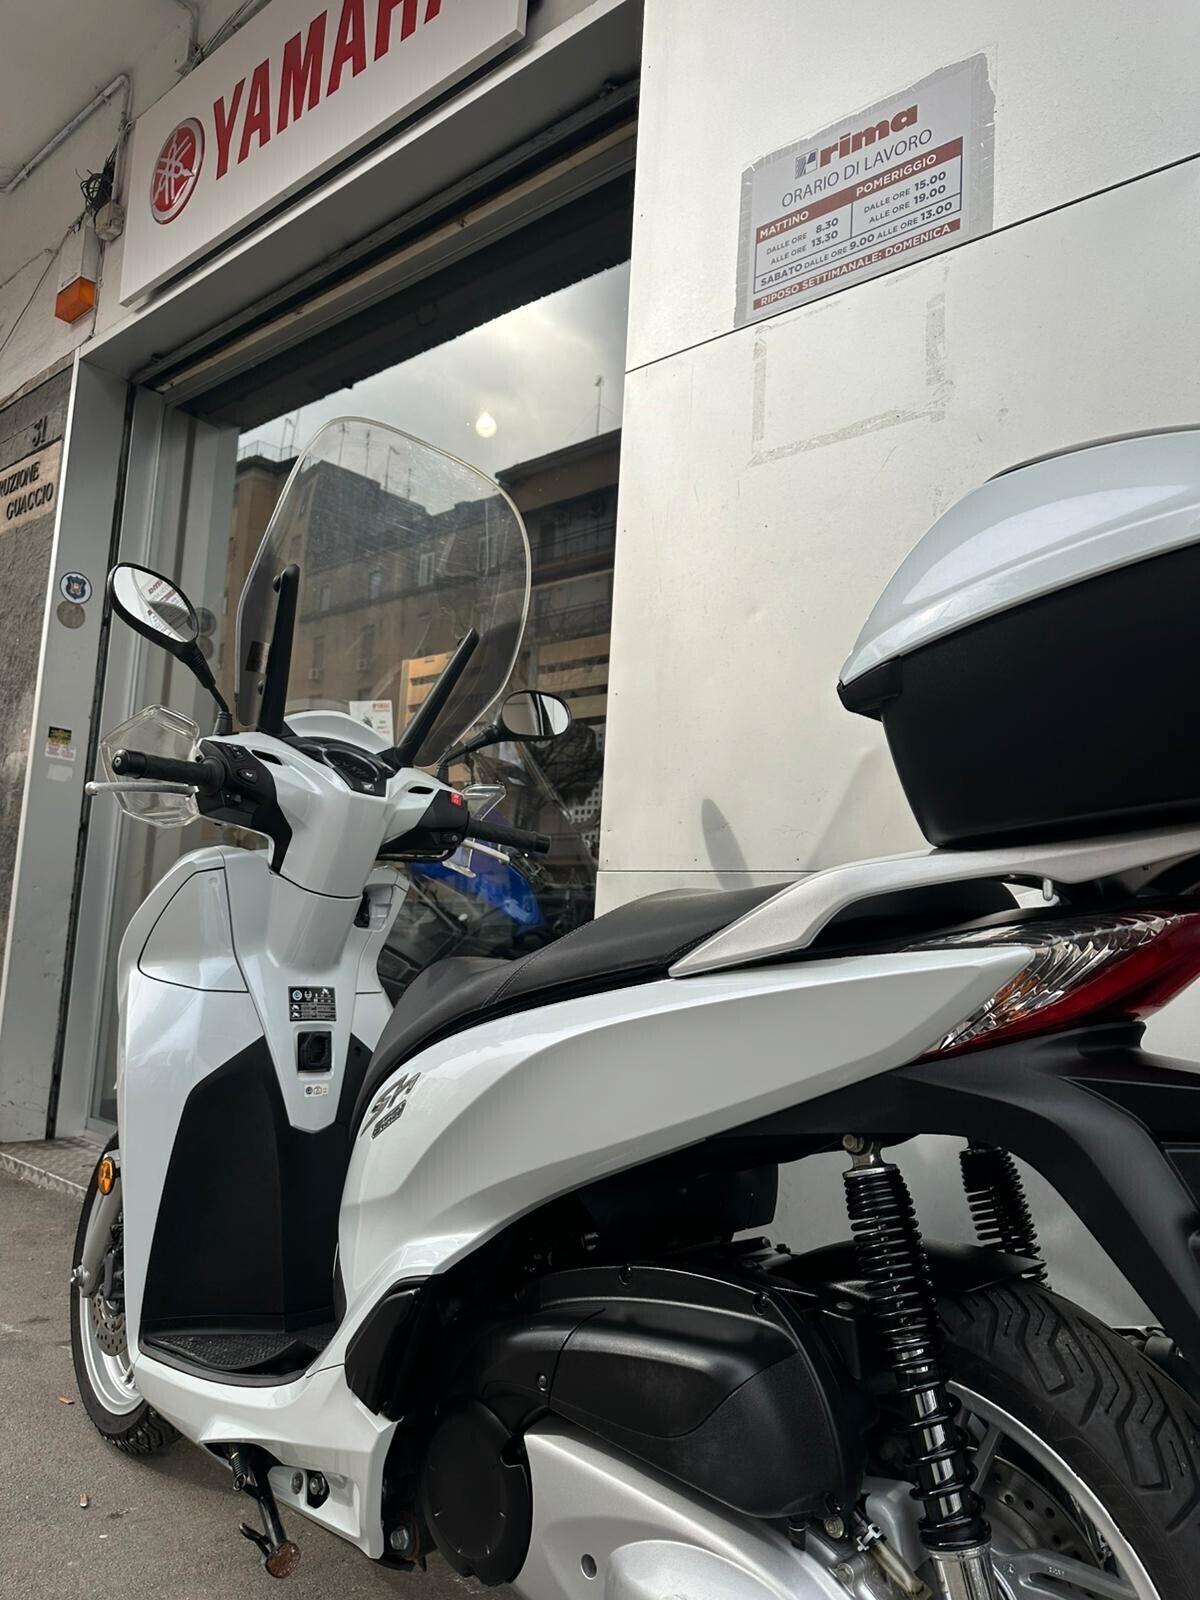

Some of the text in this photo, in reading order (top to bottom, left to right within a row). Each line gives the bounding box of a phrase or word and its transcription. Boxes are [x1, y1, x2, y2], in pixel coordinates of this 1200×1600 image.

[213, 0, 442, 181] YAMAH
[819, 104, 918, 168] rima
[782, 129, 932, 207] ORARIO DI LAVORO
[856, 154, 937, 197] POMERIGGIO
[864, 171, 946, 213] DALLE ORE 15.00
[869, 184, 946, 224] ALLE ORE 19.00
[760, 210, 809, 239] MATTINO
[760, 201, 953, 287] SABATO DALLE ORE 9.00 ALLE ORE 13.00
[766, 217, 839, 255] DALLE ORE 8.30
[760, 224, 951, 306] RIPOSO SETTIMANALE: DOMENICA
[770, 230, 838, 265] ALLE ORE 13.30
